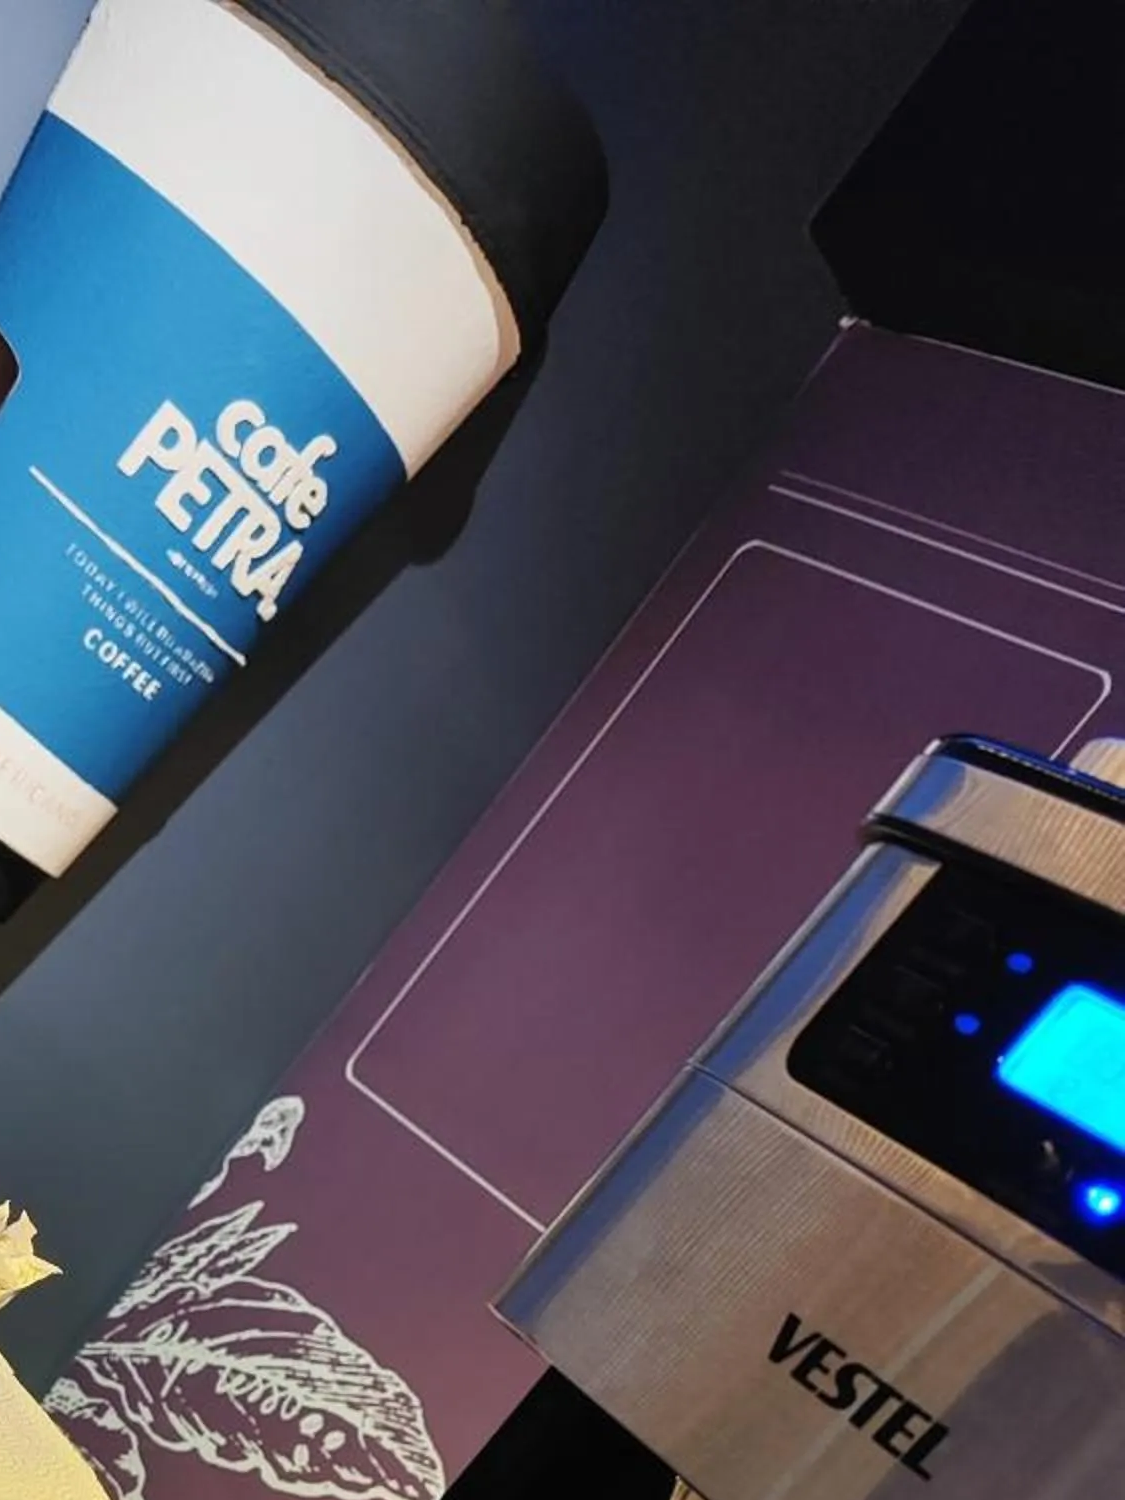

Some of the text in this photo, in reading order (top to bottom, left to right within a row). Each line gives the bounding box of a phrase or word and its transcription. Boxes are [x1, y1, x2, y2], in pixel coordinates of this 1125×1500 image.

[116, 398, 305, 622] PETRA
[65, 543, 117, 592] TODAY
[124, 599, 157, 633] WILL
[82, 583, 137, 639] THINGS
[83, 628, 163, 701] COFFEE
[767, 1311, 950, 1482] VESTEL
